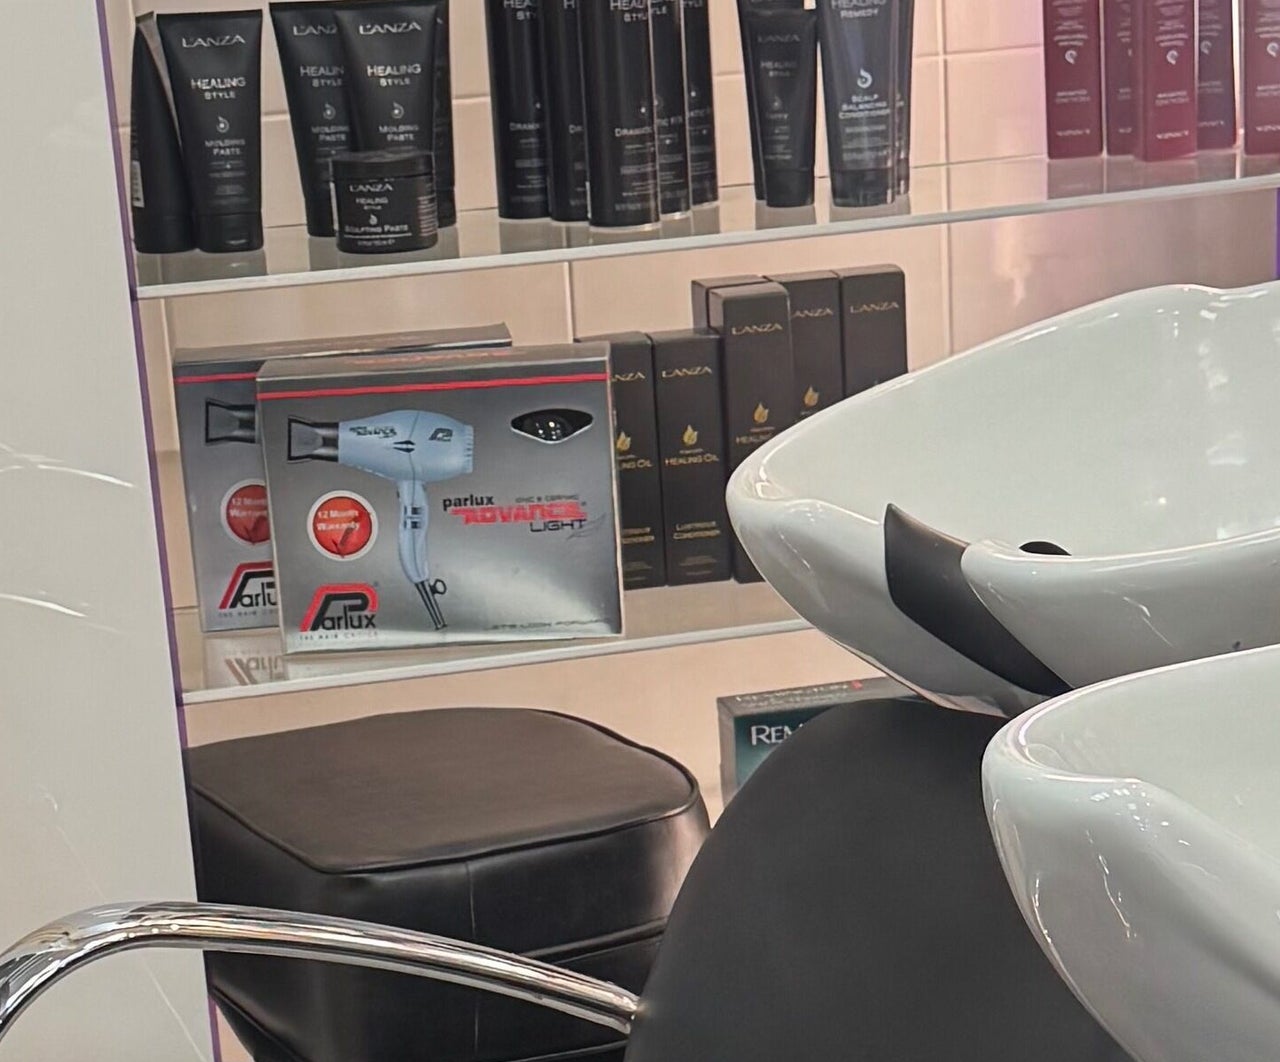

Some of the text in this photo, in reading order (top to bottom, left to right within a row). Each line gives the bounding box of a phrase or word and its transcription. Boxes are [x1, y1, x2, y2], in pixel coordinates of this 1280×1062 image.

[366, 63, 422, 77] HEALING
[190, 76, 247, 90] HEALING
[379, 77, 411, 87] STYLE
[204, 90, 237, 101] STYLE
[443, 494, 495, 512] parlux
[329, 509, 360, 518] Month
[450, 501, 588, 526] ADVANCE
[317, 521, 361, 532] Warranty
[529, 518, 588, 533] LIGHT
[218, 561, 278, 610] Parlu
[299, 582, 380, 633] Parlux
